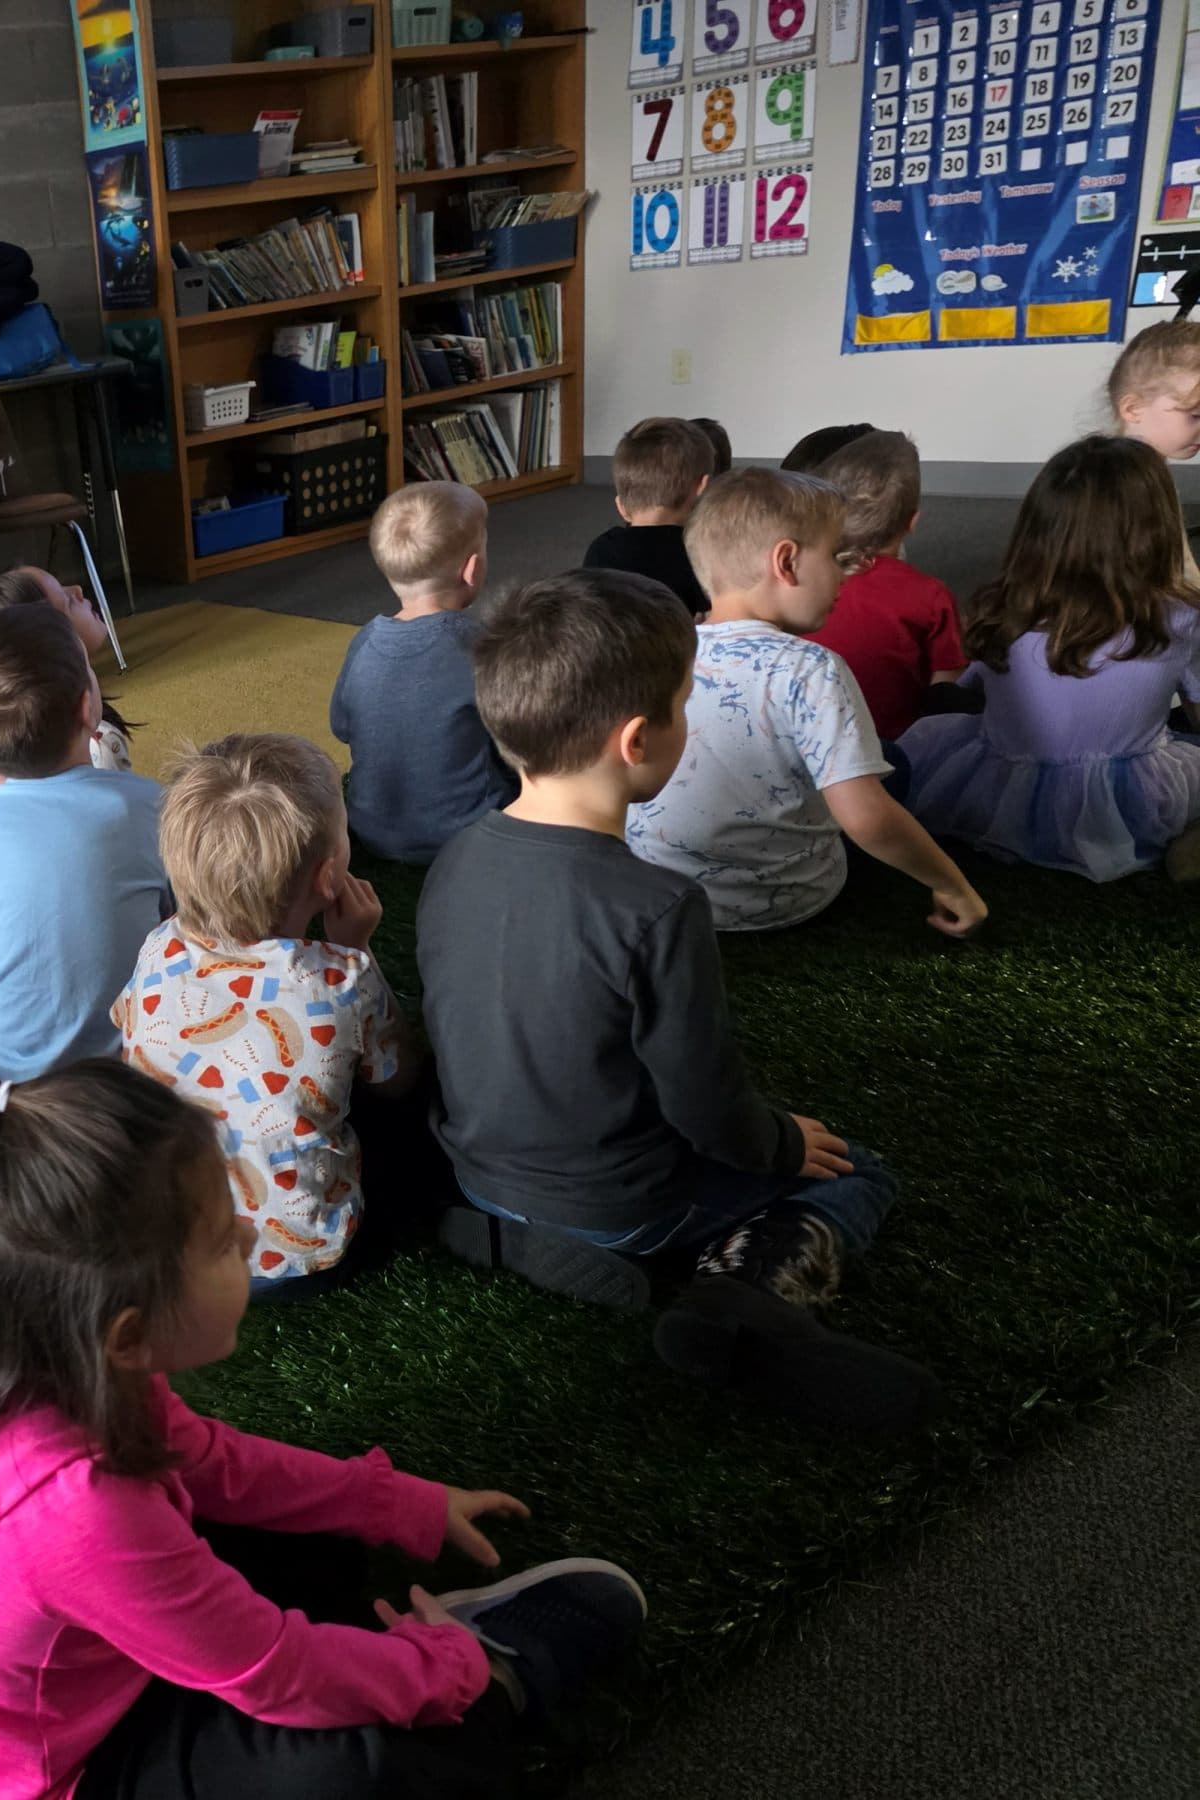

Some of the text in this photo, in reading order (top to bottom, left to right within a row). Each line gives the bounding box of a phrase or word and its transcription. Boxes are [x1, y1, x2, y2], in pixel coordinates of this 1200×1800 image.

[640, 0, 675, 67] 4
[704, 0, 739, 53] 5
[768, 0, 805, 41] 6
[922, 0, 1138, 48] 1 2 3 4 5 6
[883, 28, 1139, 86] 7 8 9 10 11 12 13
[702, 87, 736, 153] 8
[766, 70, 805, 141] 9
[878, 65, 1137, 119] 14 15 16 17 18 19 20
[644, 99, 673, 161] 7
[877, 100, 1133, 150] 21 22 23 24 25 26 27
[872, 174, 1126, 213] Today Yesterday Tomorrow Season
[873, 152, 1003, 182] 28 29 30 31
[633, 191, 679, 255] 10
[703, 181, 729, 248] 11
[755, 174, 807, 242] 12
[940, 243, 1028, 261] Today's Weather
